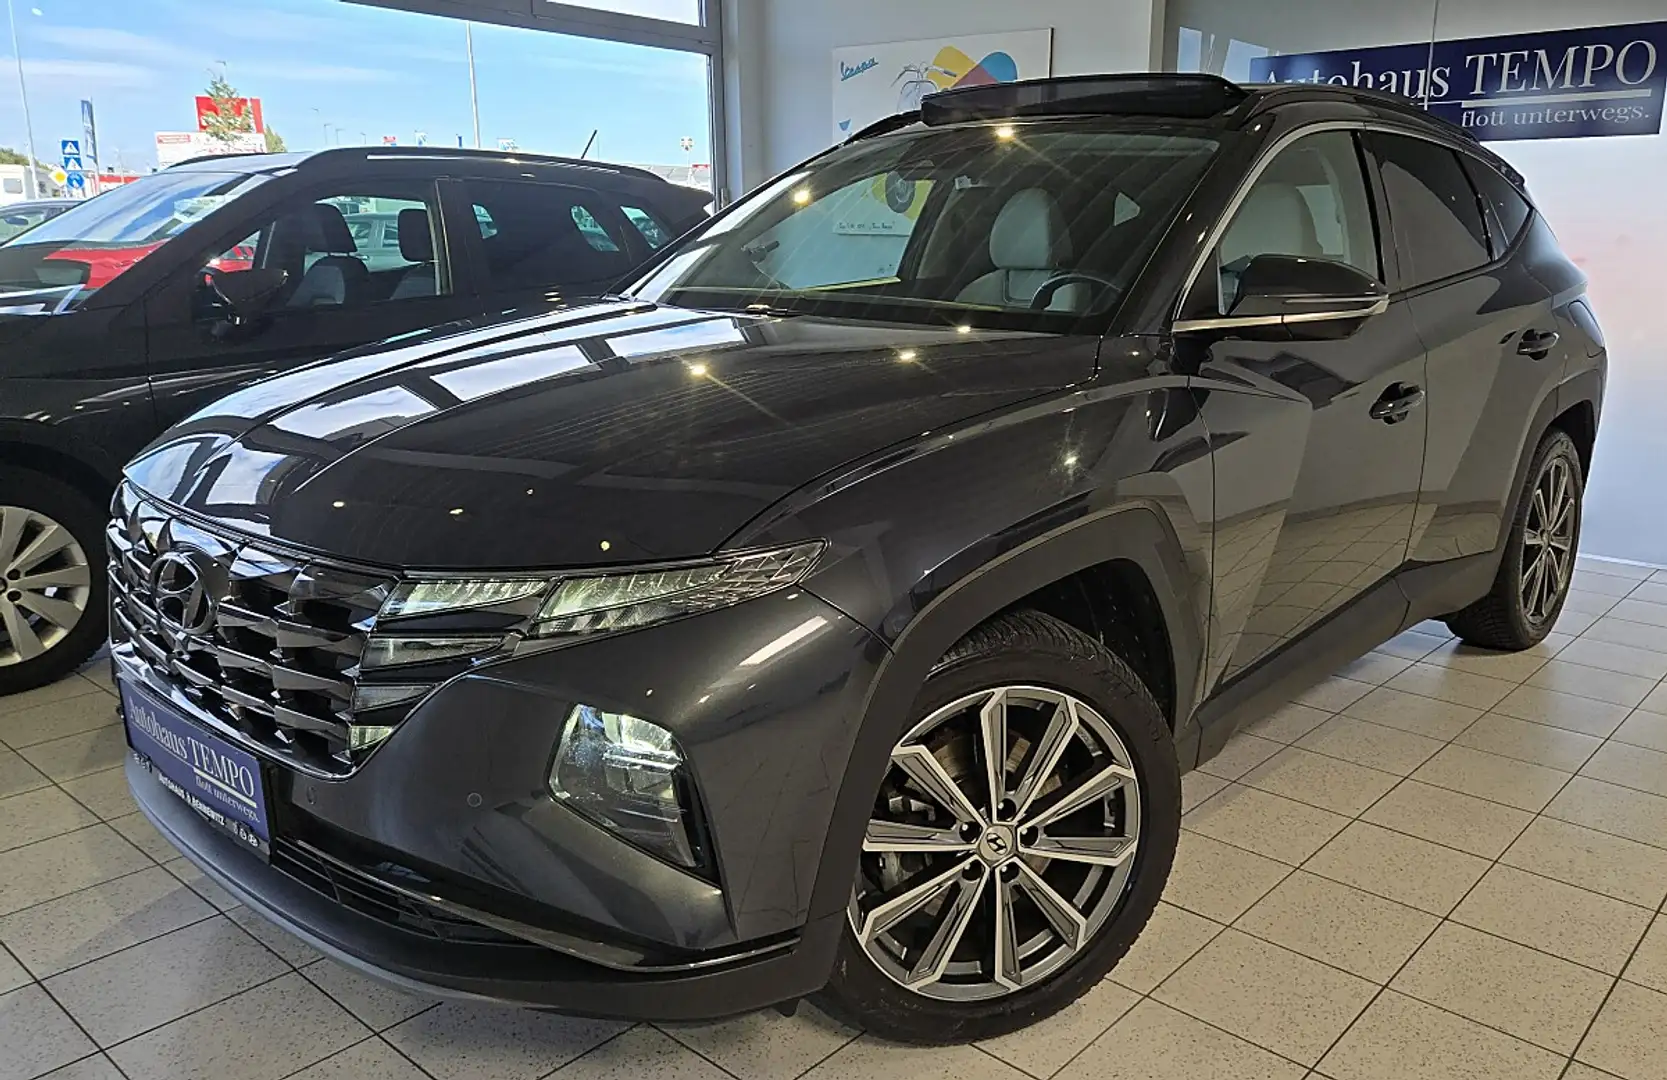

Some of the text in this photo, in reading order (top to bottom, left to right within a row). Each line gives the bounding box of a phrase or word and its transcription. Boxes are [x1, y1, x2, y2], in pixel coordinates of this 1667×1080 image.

[840, 57, 879, 82] Vespa
[1267, 40, 1657, 99] haus TEMPO
[1461, 105, 1650, 128] flott unterwegs.
[129, 696, 255, 798] Autohaus TEMPO
